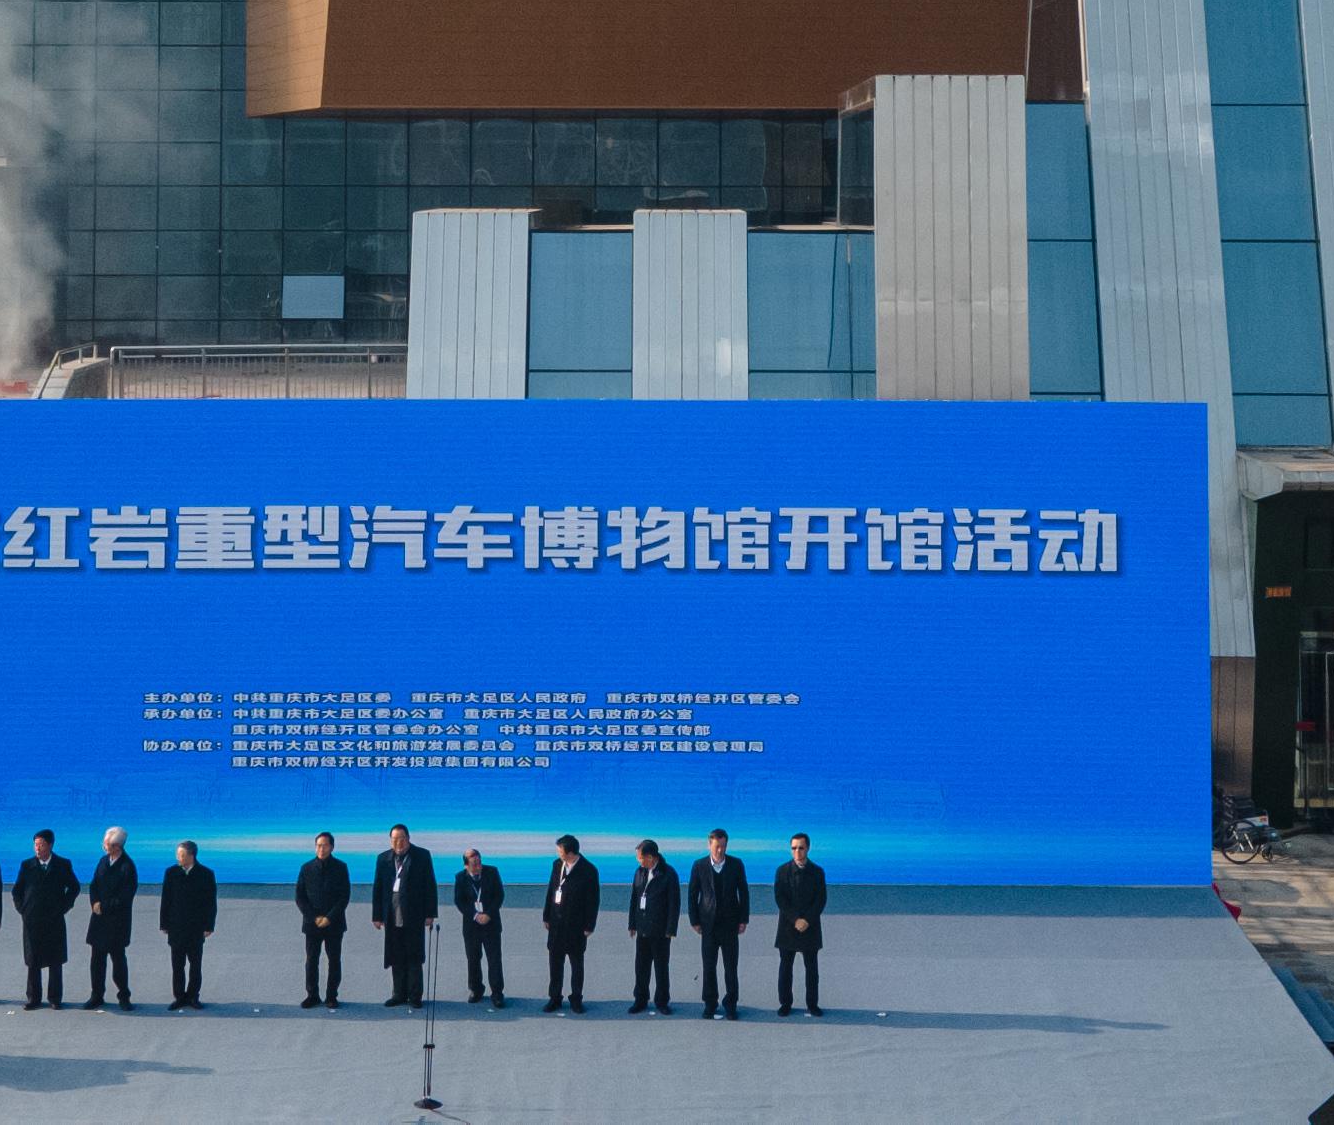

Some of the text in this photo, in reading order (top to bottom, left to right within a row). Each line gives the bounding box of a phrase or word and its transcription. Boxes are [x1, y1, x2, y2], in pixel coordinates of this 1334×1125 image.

[411, 692, 586, 705] 重庆市大足区人民政府
[607, 692, 800, 705] 重庆市双桥经开区管委会
[464, 708, 693, 720] 重庆市大足区人民政府办公室
[233, 724, 711, 736] 重庆市双桥经开区管委会办公室 中共重庆市大足区委宣传部
